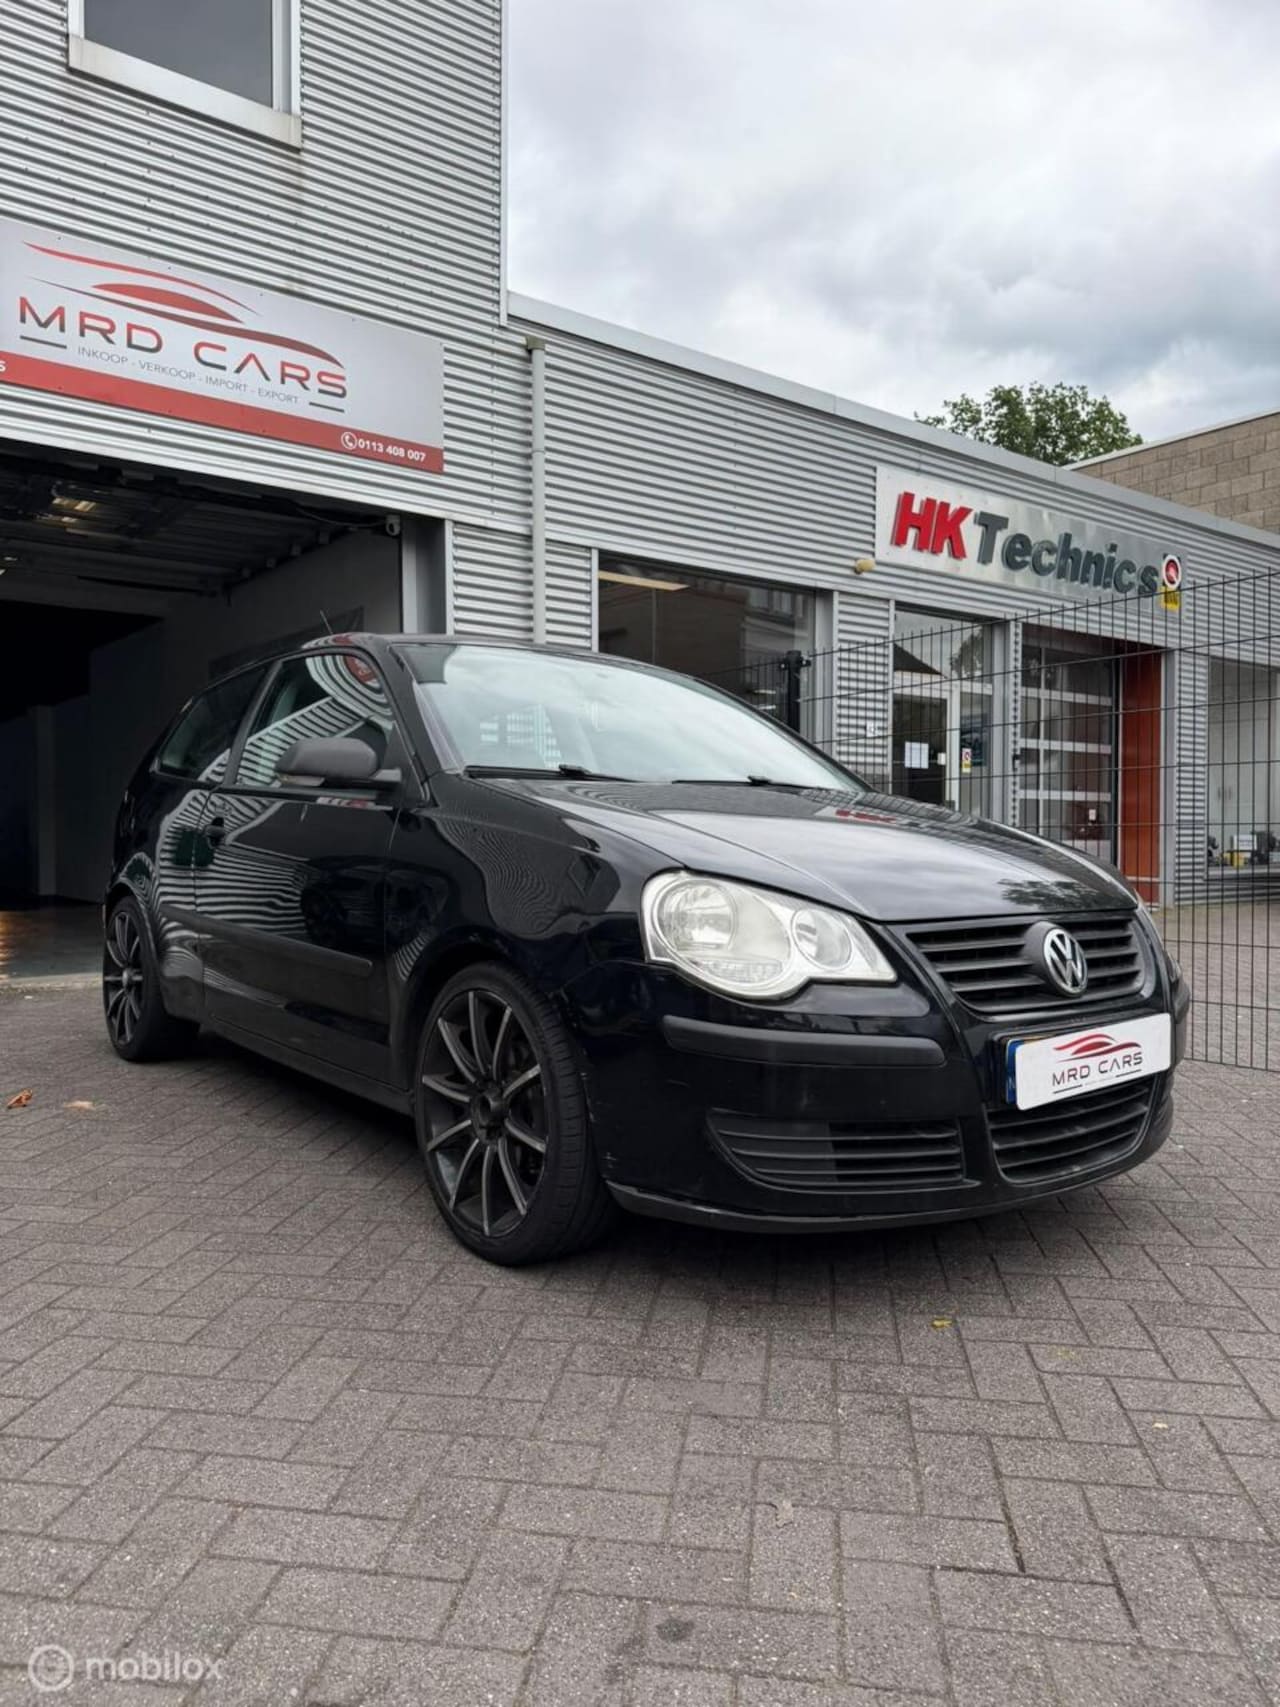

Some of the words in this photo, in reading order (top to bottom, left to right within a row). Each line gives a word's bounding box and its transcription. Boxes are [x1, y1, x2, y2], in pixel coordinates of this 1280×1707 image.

[19, 296, 163, 354] MRD
[193, 341, 347, 399] CARS
[77, 346, 129, 367] INKOOP
[138, 359, 196, 381] VERKOOP
[205, 375, 249, 393] IMPORT
[258, 387, 299, 404] EXPORT
[358, 438, 384, 453] 0113
[386, 445, 405, 457] 408
[407, 449, 426, 462] 007
[1052, 1065, 1090, 1087] MRD
[1098, 1052, 1143, 1074] CARS
